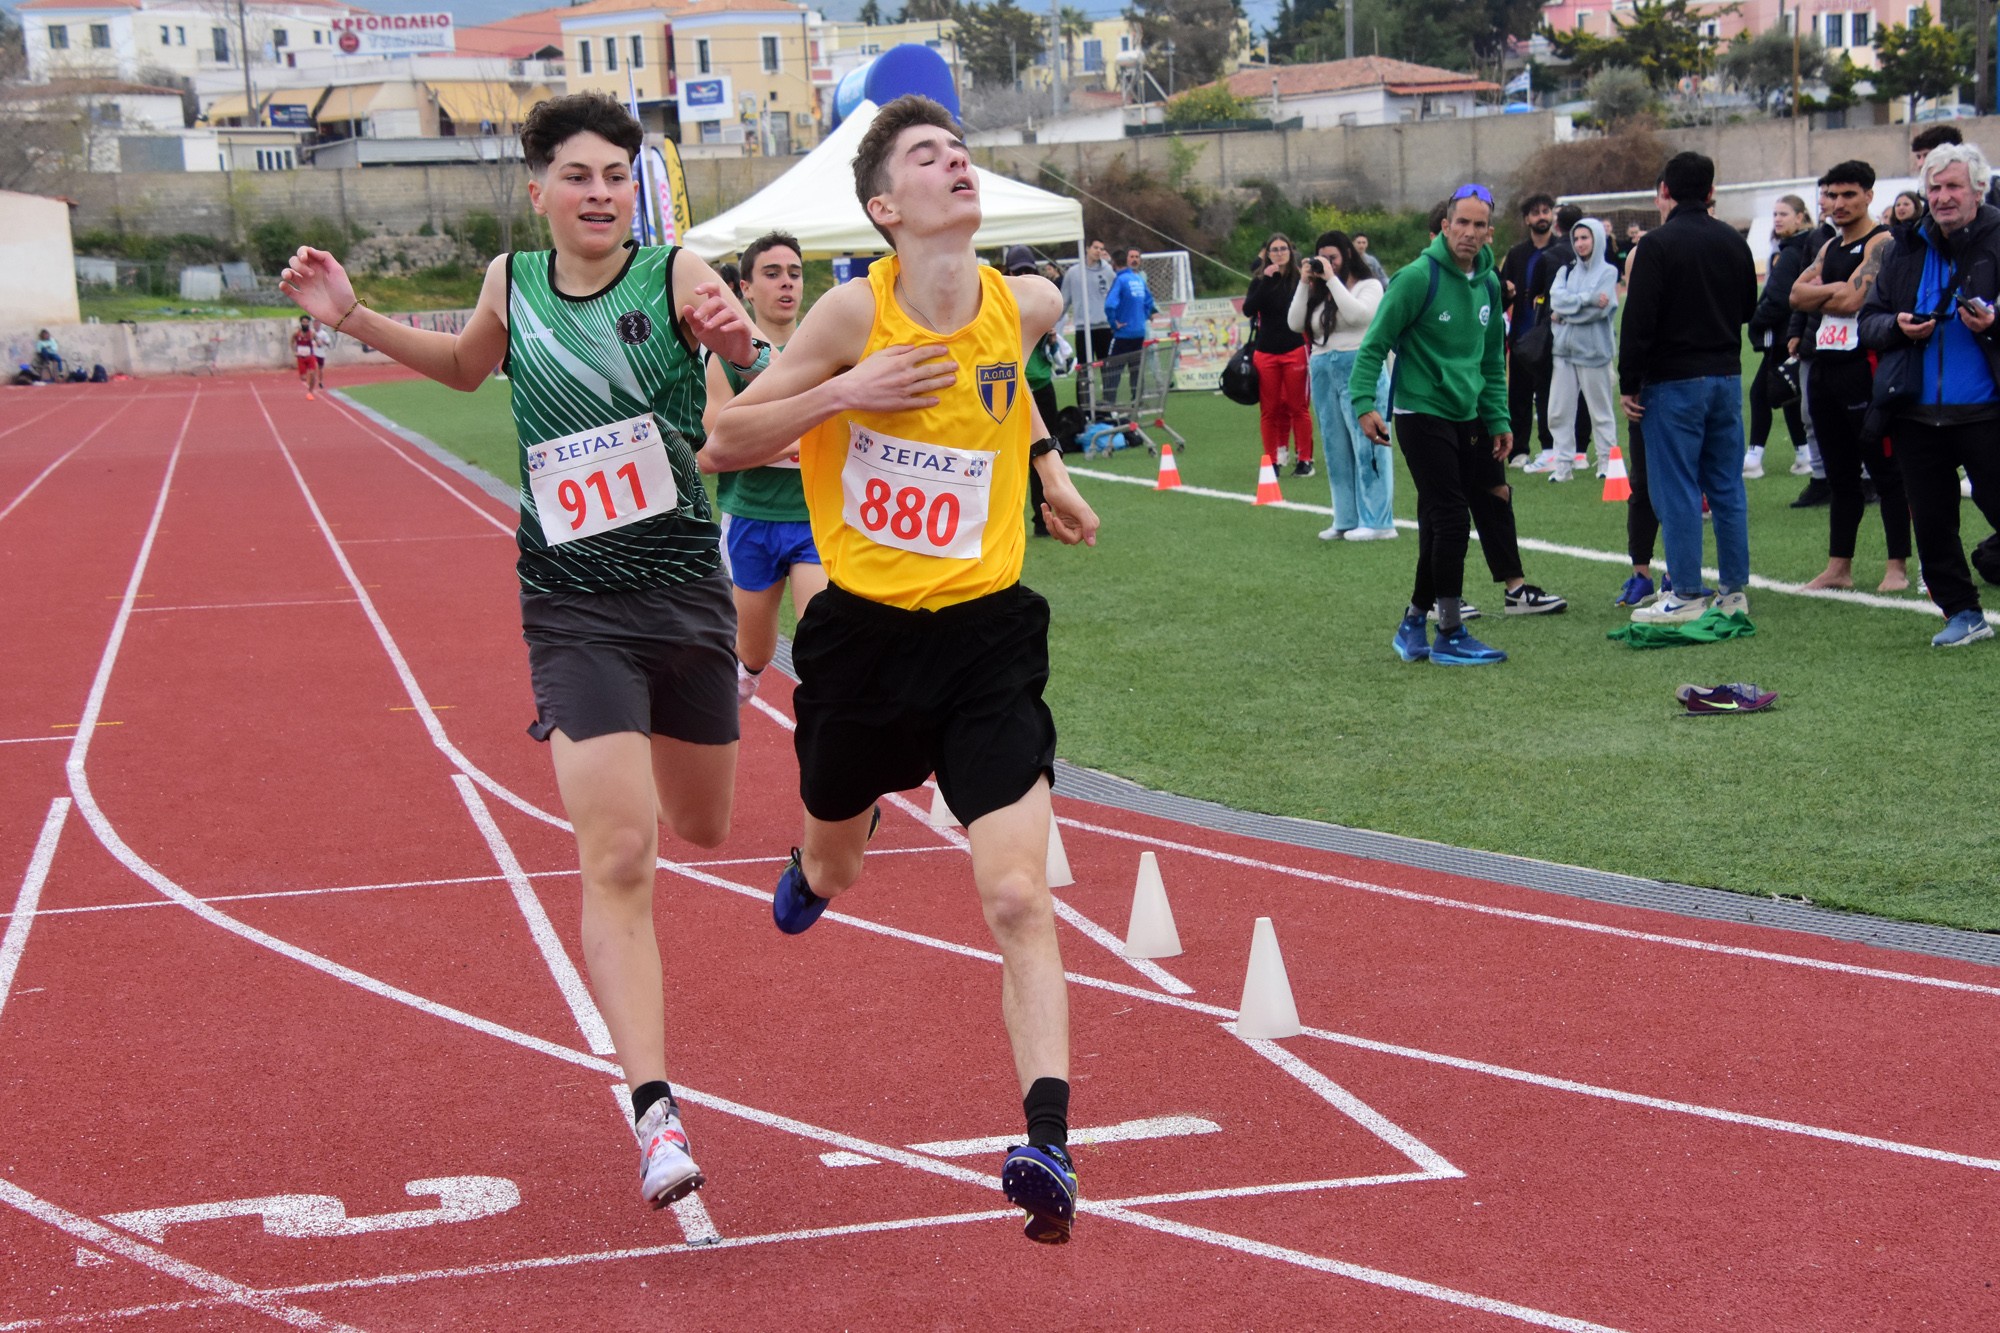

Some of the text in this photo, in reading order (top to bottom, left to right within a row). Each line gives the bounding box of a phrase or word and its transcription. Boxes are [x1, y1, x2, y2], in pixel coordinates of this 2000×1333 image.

[332, 14, 450, 31] ΚΡΕΟΠΩΛΕΙΟ
[555, 431, 624, 462] ΣΕΓΑΣ
[880, 444, 957, 473] ΣΕΓΑΣ
[557, 461, 647, 531] 911
[859, 478, 960, 547] 880
